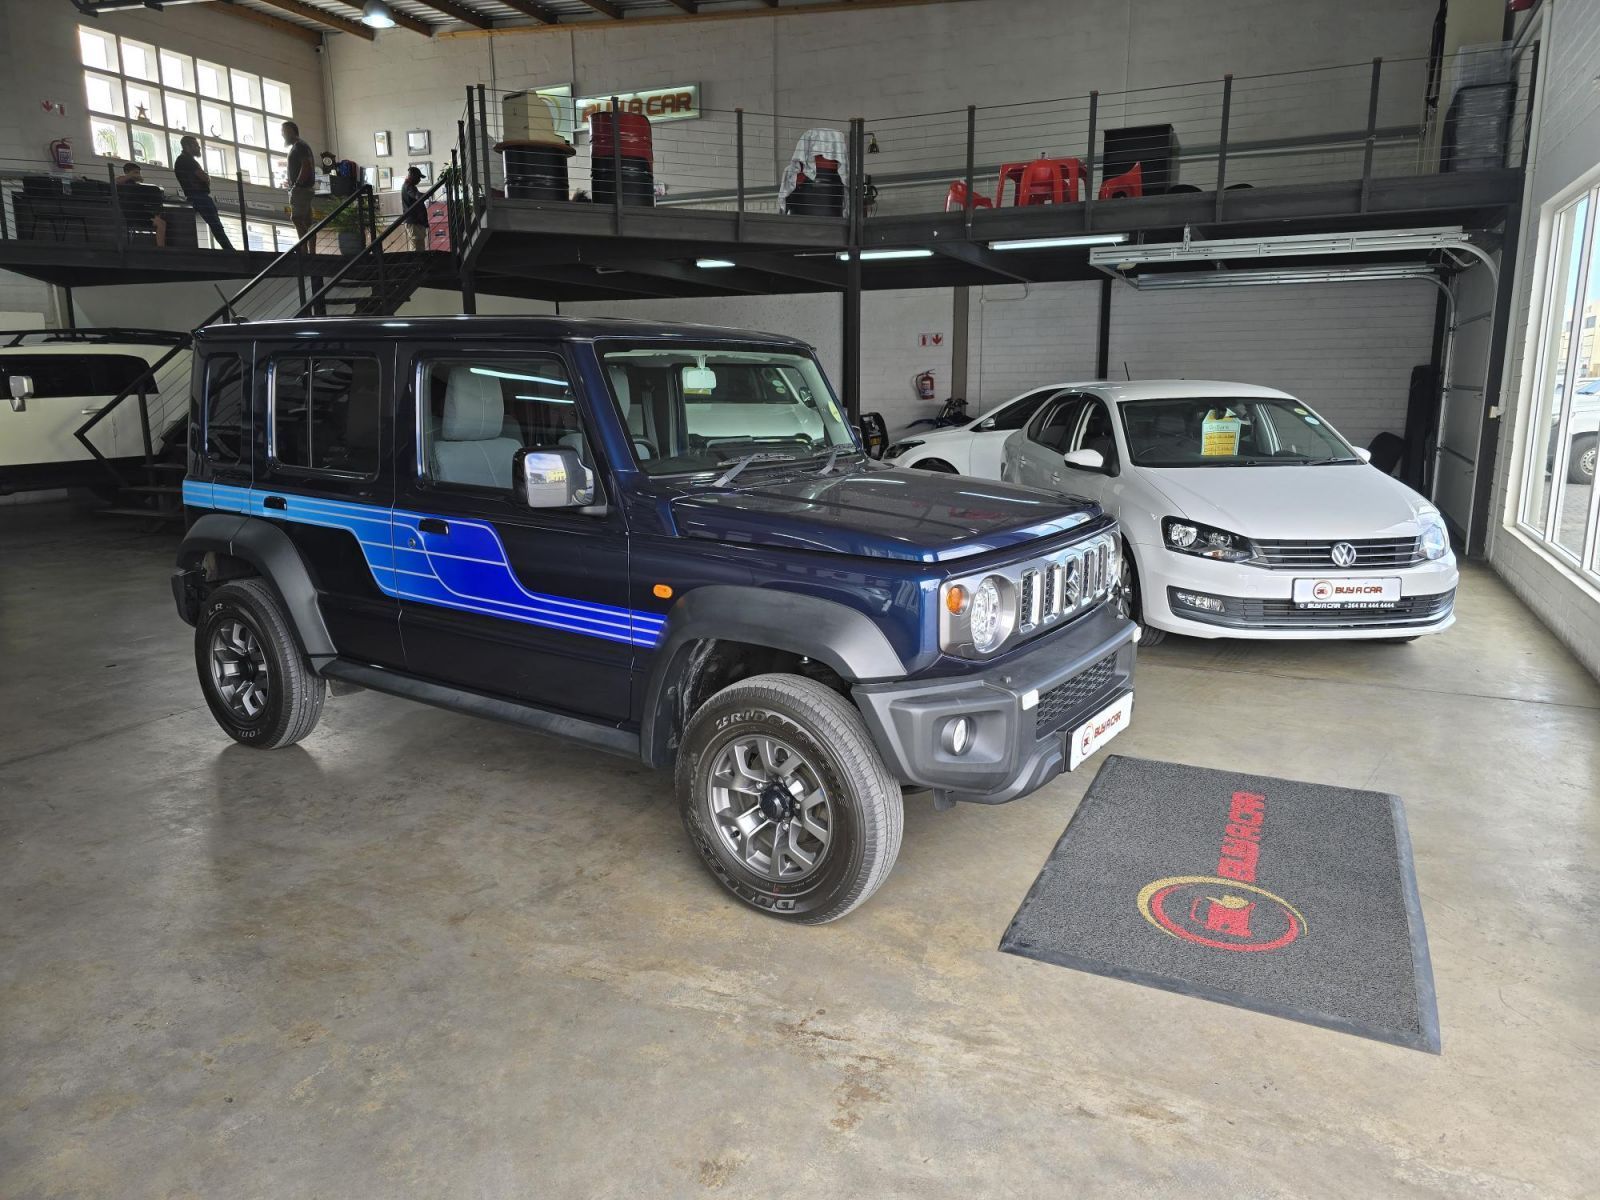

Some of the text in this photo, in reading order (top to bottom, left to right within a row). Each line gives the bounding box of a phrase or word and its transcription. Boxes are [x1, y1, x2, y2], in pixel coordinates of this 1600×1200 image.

[629, 98, 642, 115] A
[647, 92, 692, 115] CAR
[1355, 586, 1362, 594] A
[1363, 586, 1383, 594] CAR
[1111, 710, 1121, 725] CAR
[1229, 791, 1265, 827] CAR
